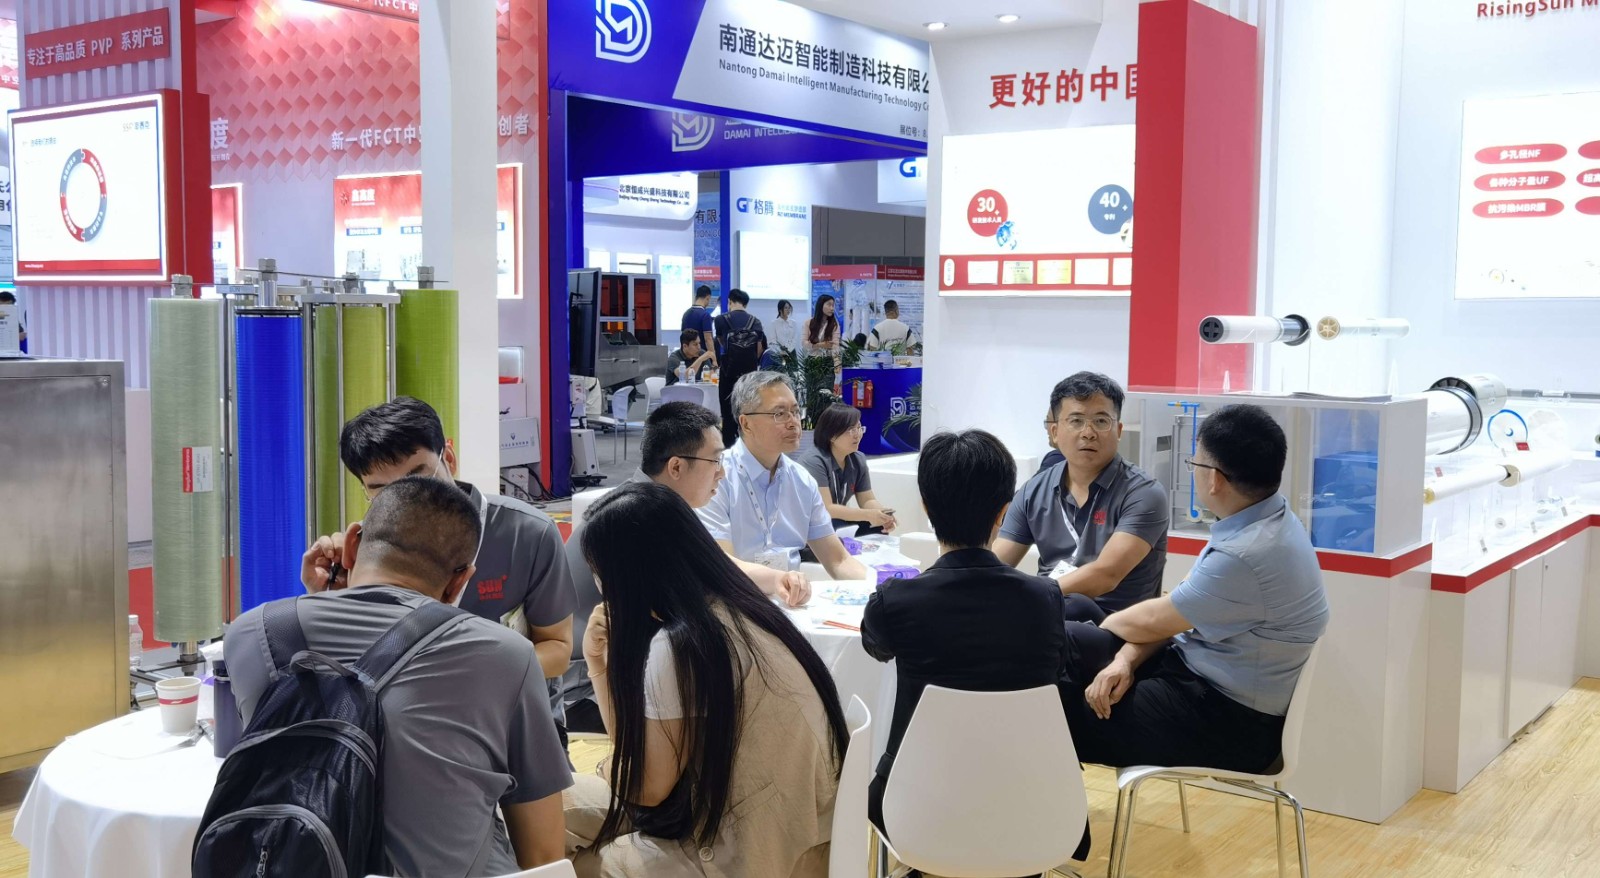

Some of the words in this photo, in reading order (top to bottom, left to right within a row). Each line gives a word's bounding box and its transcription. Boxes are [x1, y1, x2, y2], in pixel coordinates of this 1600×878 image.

[1477, 0, 1574, 17] RisingSun
[27, 39, 86, 66] 专注于高品质
[91, 37, 113, 56] PVP
[121, 26, 164, 51] 系列产品
[719, 58, 757, 79] Nantong
[759, 66, 786, 82] Damai
[787, 72, 829, 90] Intelligent
[829, 81, 883, 104] Manufacturing
[884, 93, 922, 112] Technology
[331, 124, 421, 151] 新一代FCT中
[724, 129, 751, 140] DAMAI
[754, 199, 774, 216] 格腾
[695, 208, 720, 225] 有限
